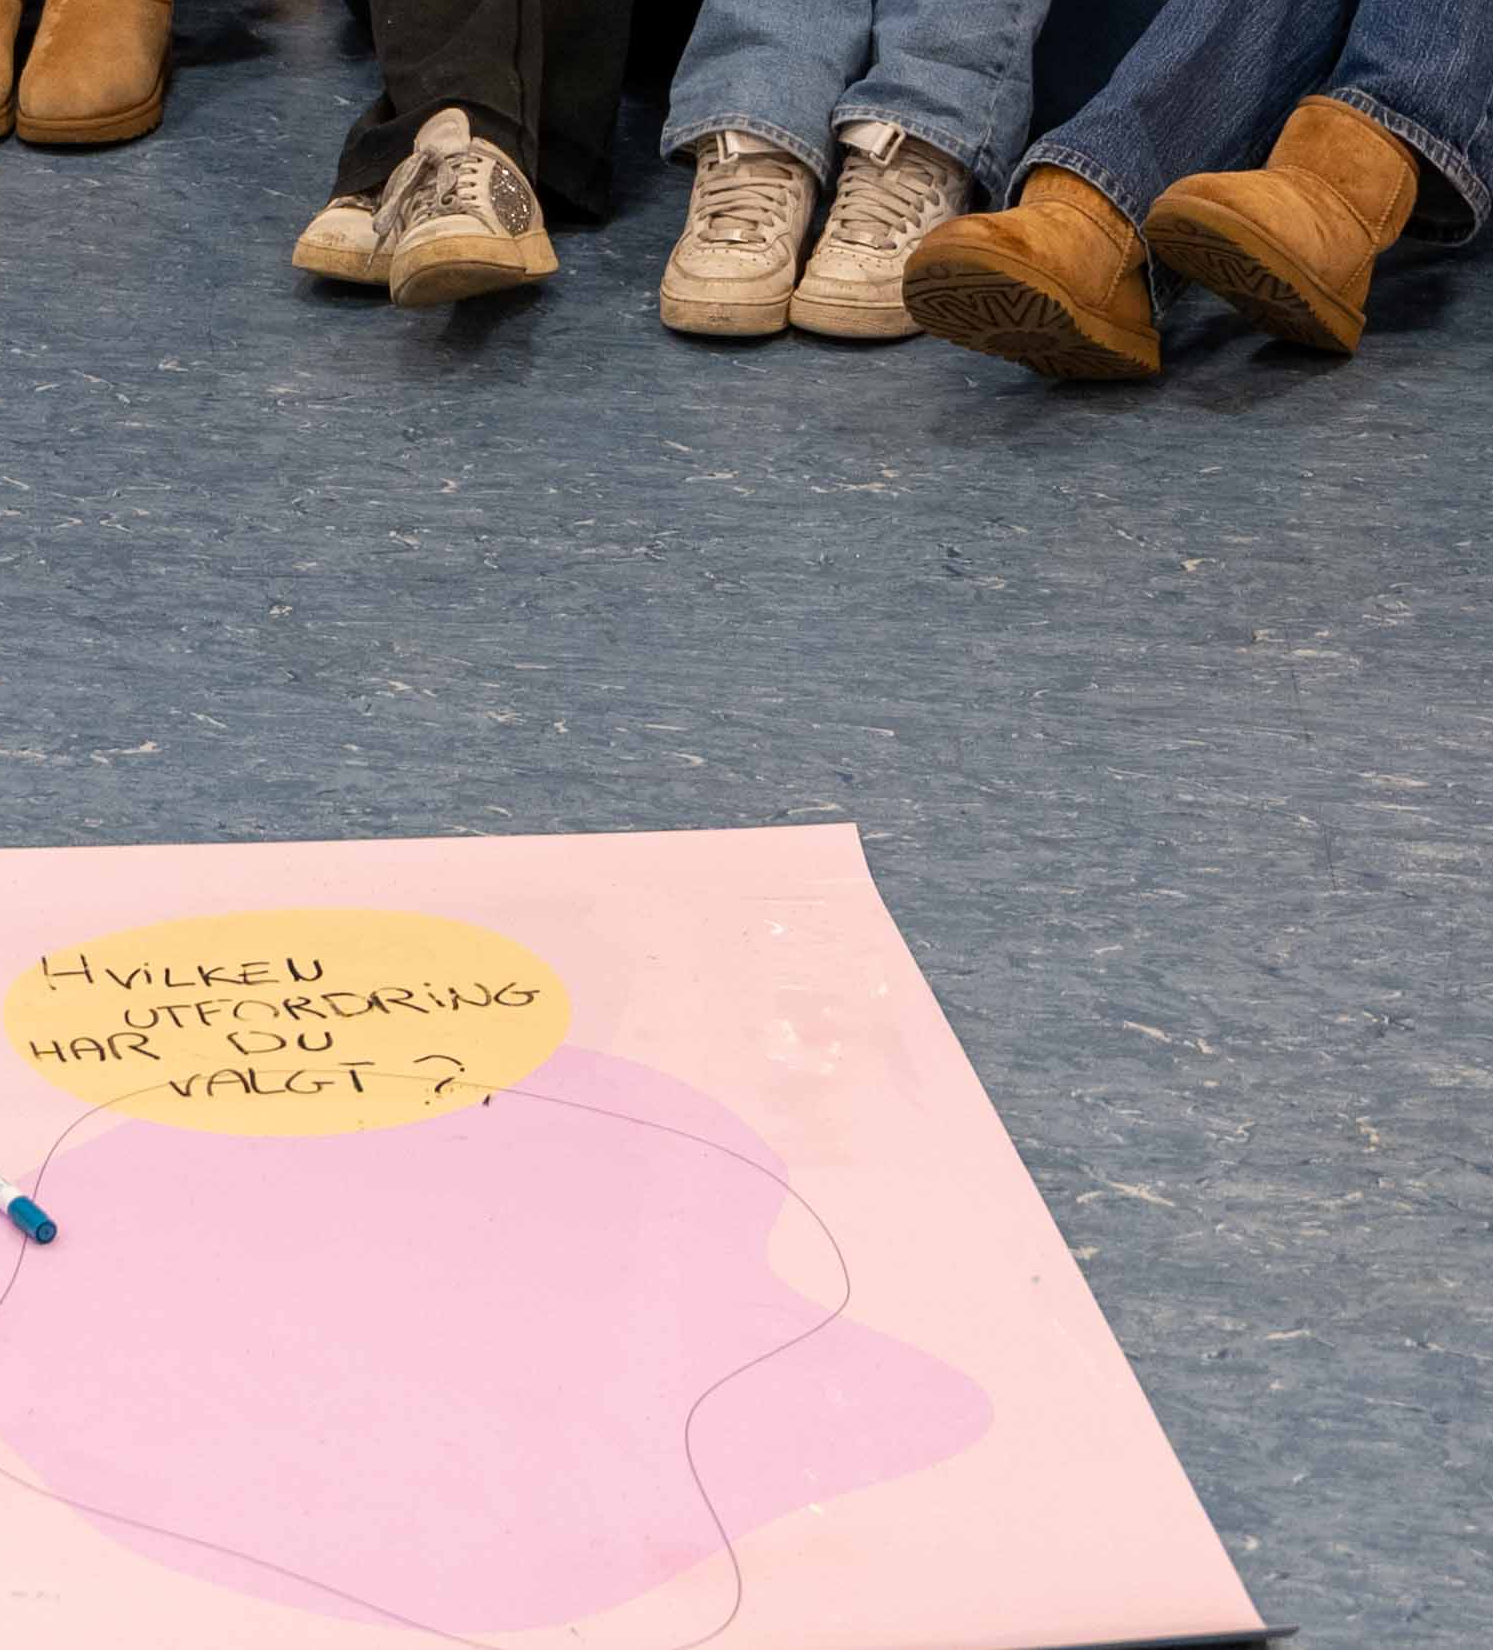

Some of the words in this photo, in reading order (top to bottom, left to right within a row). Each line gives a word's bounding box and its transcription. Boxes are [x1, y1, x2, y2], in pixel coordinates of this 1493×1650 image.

[29, 1032, 161, 1063] HAR
[227, 1030, 334, 1055] DU
[169, 1061, 376, 1098] VALGT
